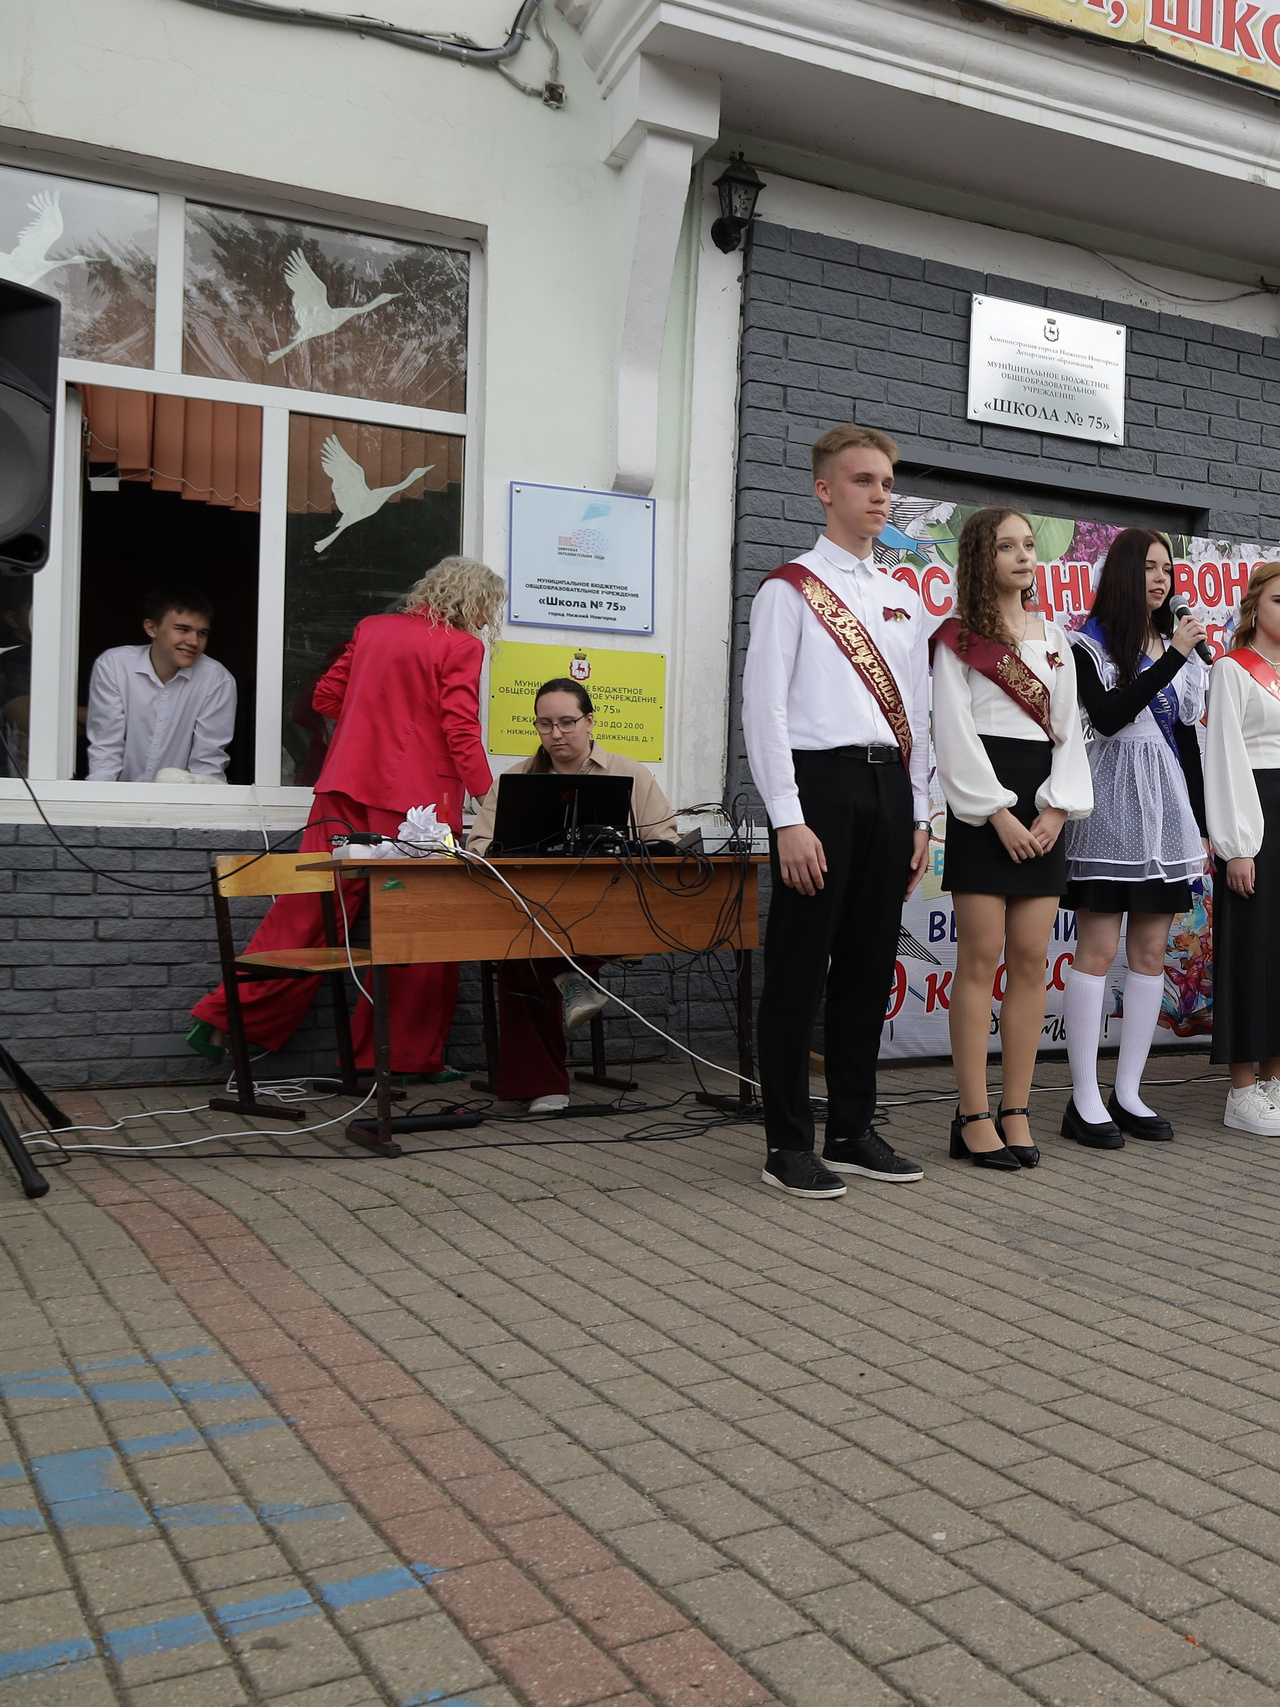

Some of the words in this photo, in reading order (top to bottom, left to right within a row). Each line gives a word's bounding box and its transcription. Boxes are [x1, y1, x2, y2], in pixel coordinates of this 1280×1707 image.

[989, 335, 1037, 350] Администрация
[1038, 345, 1058, 355] города
[1060, 349, 1087, 360] Нижнего
[1088, 355, 1119, 367] Новгорода
[1016, 349, 1055, 362] Департамент
[1057, 356, 1093, 369] образования
[987, 361, 1060, 380] МУНИЦИПАЛЬНОЕ
[1061, 375, 1110, 390] БЮДЖЕТНОЕ
[1001, 372, 1097, 396] ОБЩЕОБРАЗОВАТЕЛЬНОЕ
[1023, 385, 1076, 401] УЧРЕЖДЕНИЕ
[984, 398, 1060, 423] «ШКОЛА
[1064, 411, 1084, 427] №
[1088, 415, 1110, 431] 75»
[525, 583, 600, 595] ОБЩЕОБРАЗОВАТЕЛЬНОЕ
[601, 590, 639, 598] УЧРЕЖДЕНИЕ
[537, 578, 590, 588] МУНИЦИПАЛЬНОЕ
[591, 583, 628, 591] БЮДЖЕТНОЕ
[538, 596, 587, 609] «Школа
[590, 600, 603, 610] №
[606, 601, 626, 612] 75»
[592, 685, 643, 695] БЮДЖЕТНОЕ
[605, 694, 657, 704] УЧРЕЖДЕНИЕ
[603, 705, 621, 714] 75»
[511, 715, 536, 723] РЕЖИ
[610, 721, 622, 729] ДО
[624, 721, 644, 730] 20.00
[596, 733, 641, 743] ДВИЖЕНЦЕВ,
